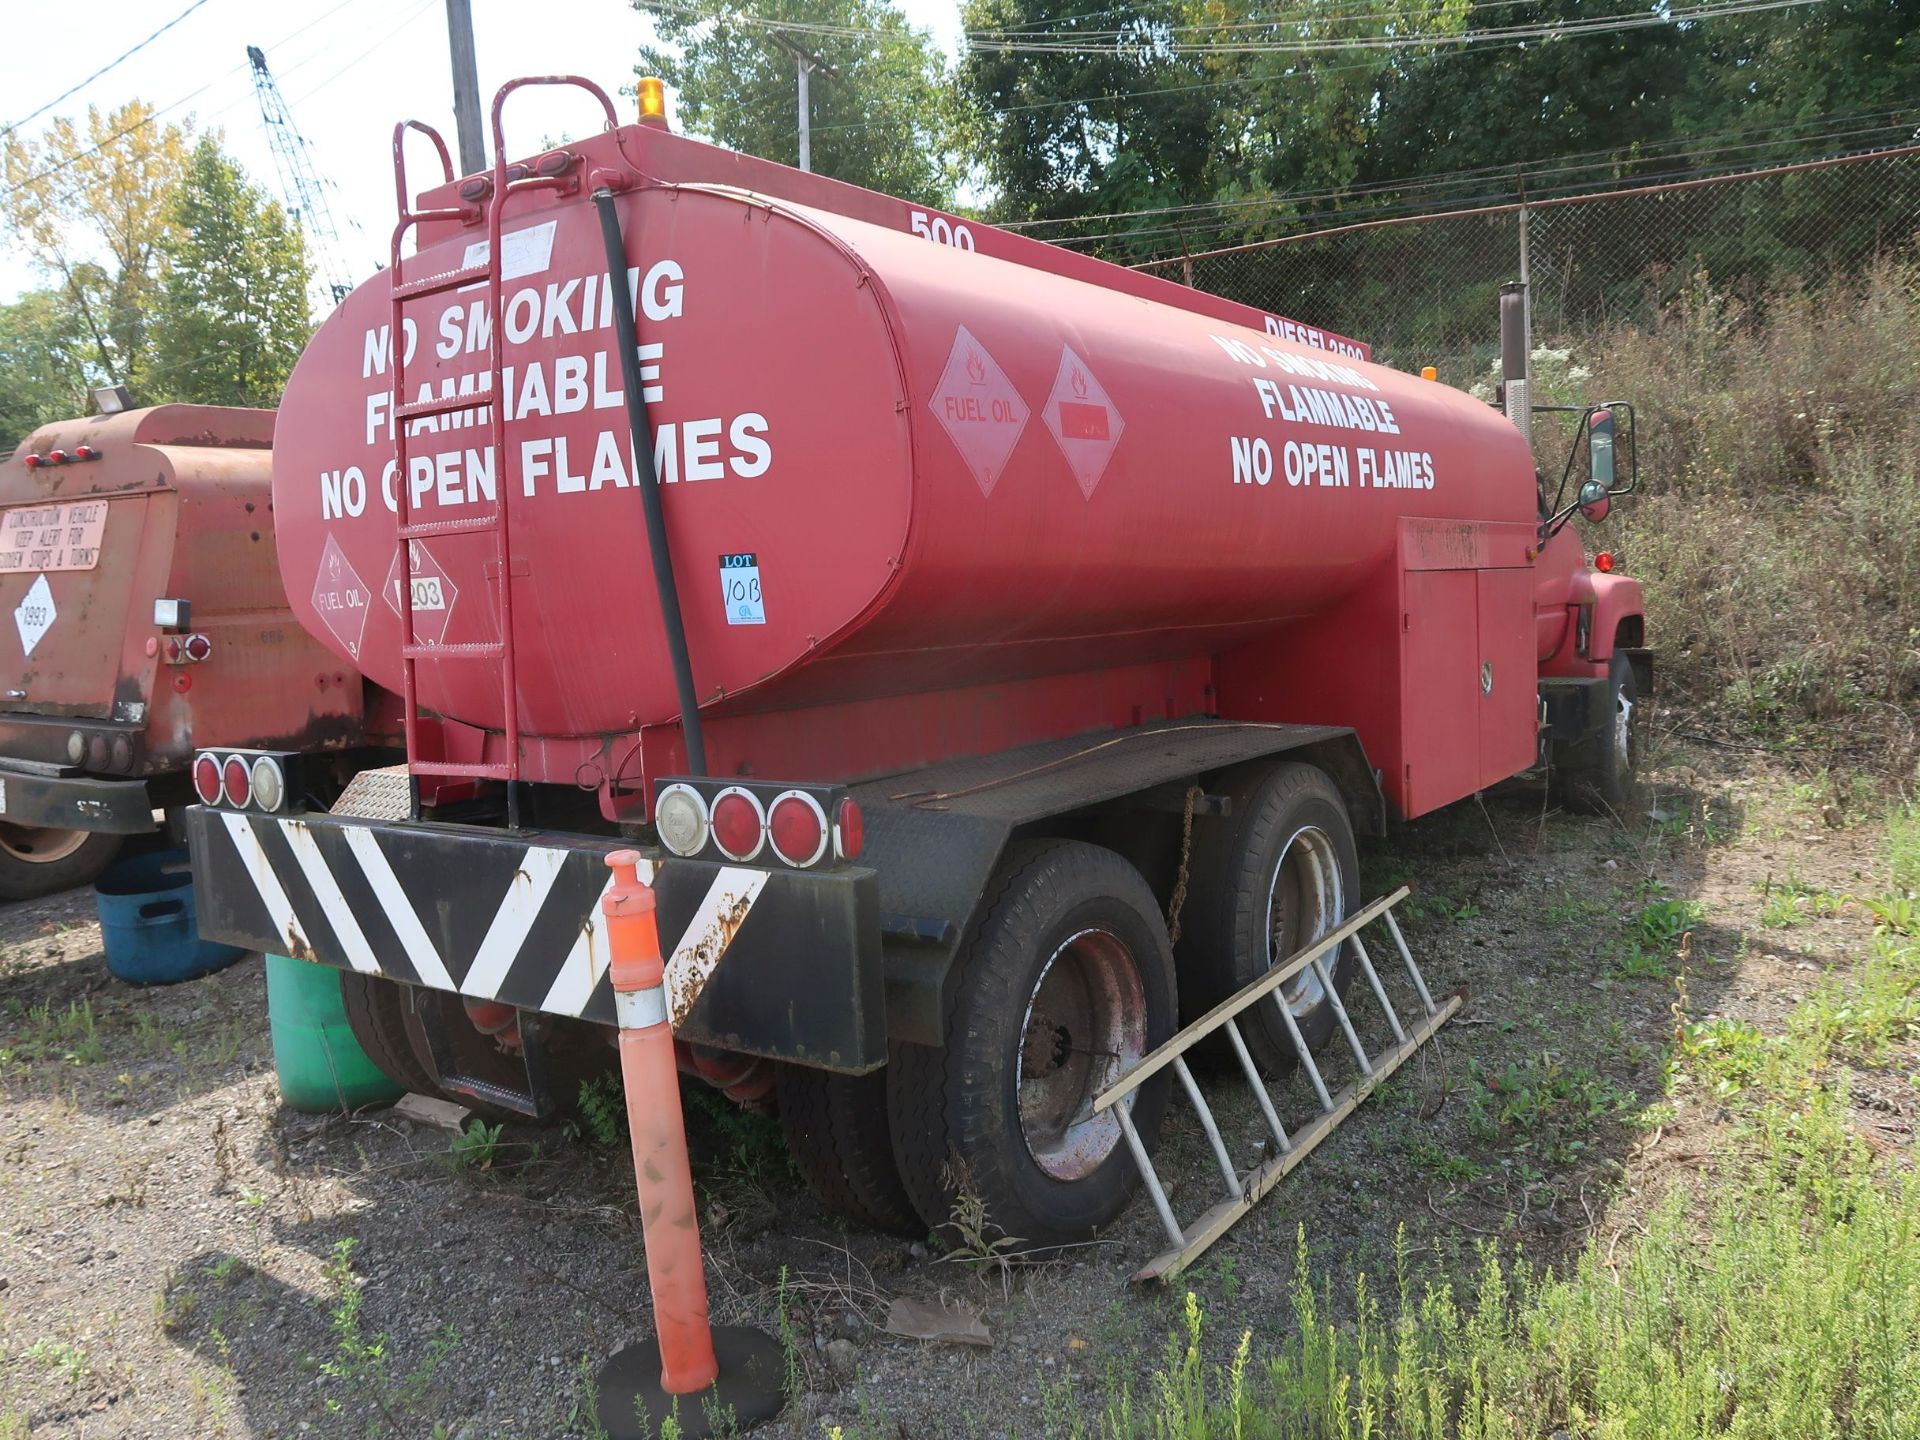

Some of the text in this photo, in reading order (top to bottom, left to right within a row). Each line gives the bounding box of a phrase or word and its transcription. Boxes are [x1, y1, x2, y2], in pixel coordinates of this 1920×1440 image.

[911, 210, 975, 254] 500
[363, 259, 684, 379] NO SMOKING
[1208, 334, 1380, 391] NO SMOKING
[944, 396, 1018, 423] FUEL OIL
[1252, 377, 1400, 435] FLAMMABLE
[320, 412, 773, 520] NO OPEN FLAMES
[1230, 436, 1435, 490] NO OPEN FLAMES
[724, 554, 753, 568] LOT
[23, 607, 46, 626] 1993
[319, 589, 363, 610] FUEL OIL
[349, 641, 357, 654] 3
